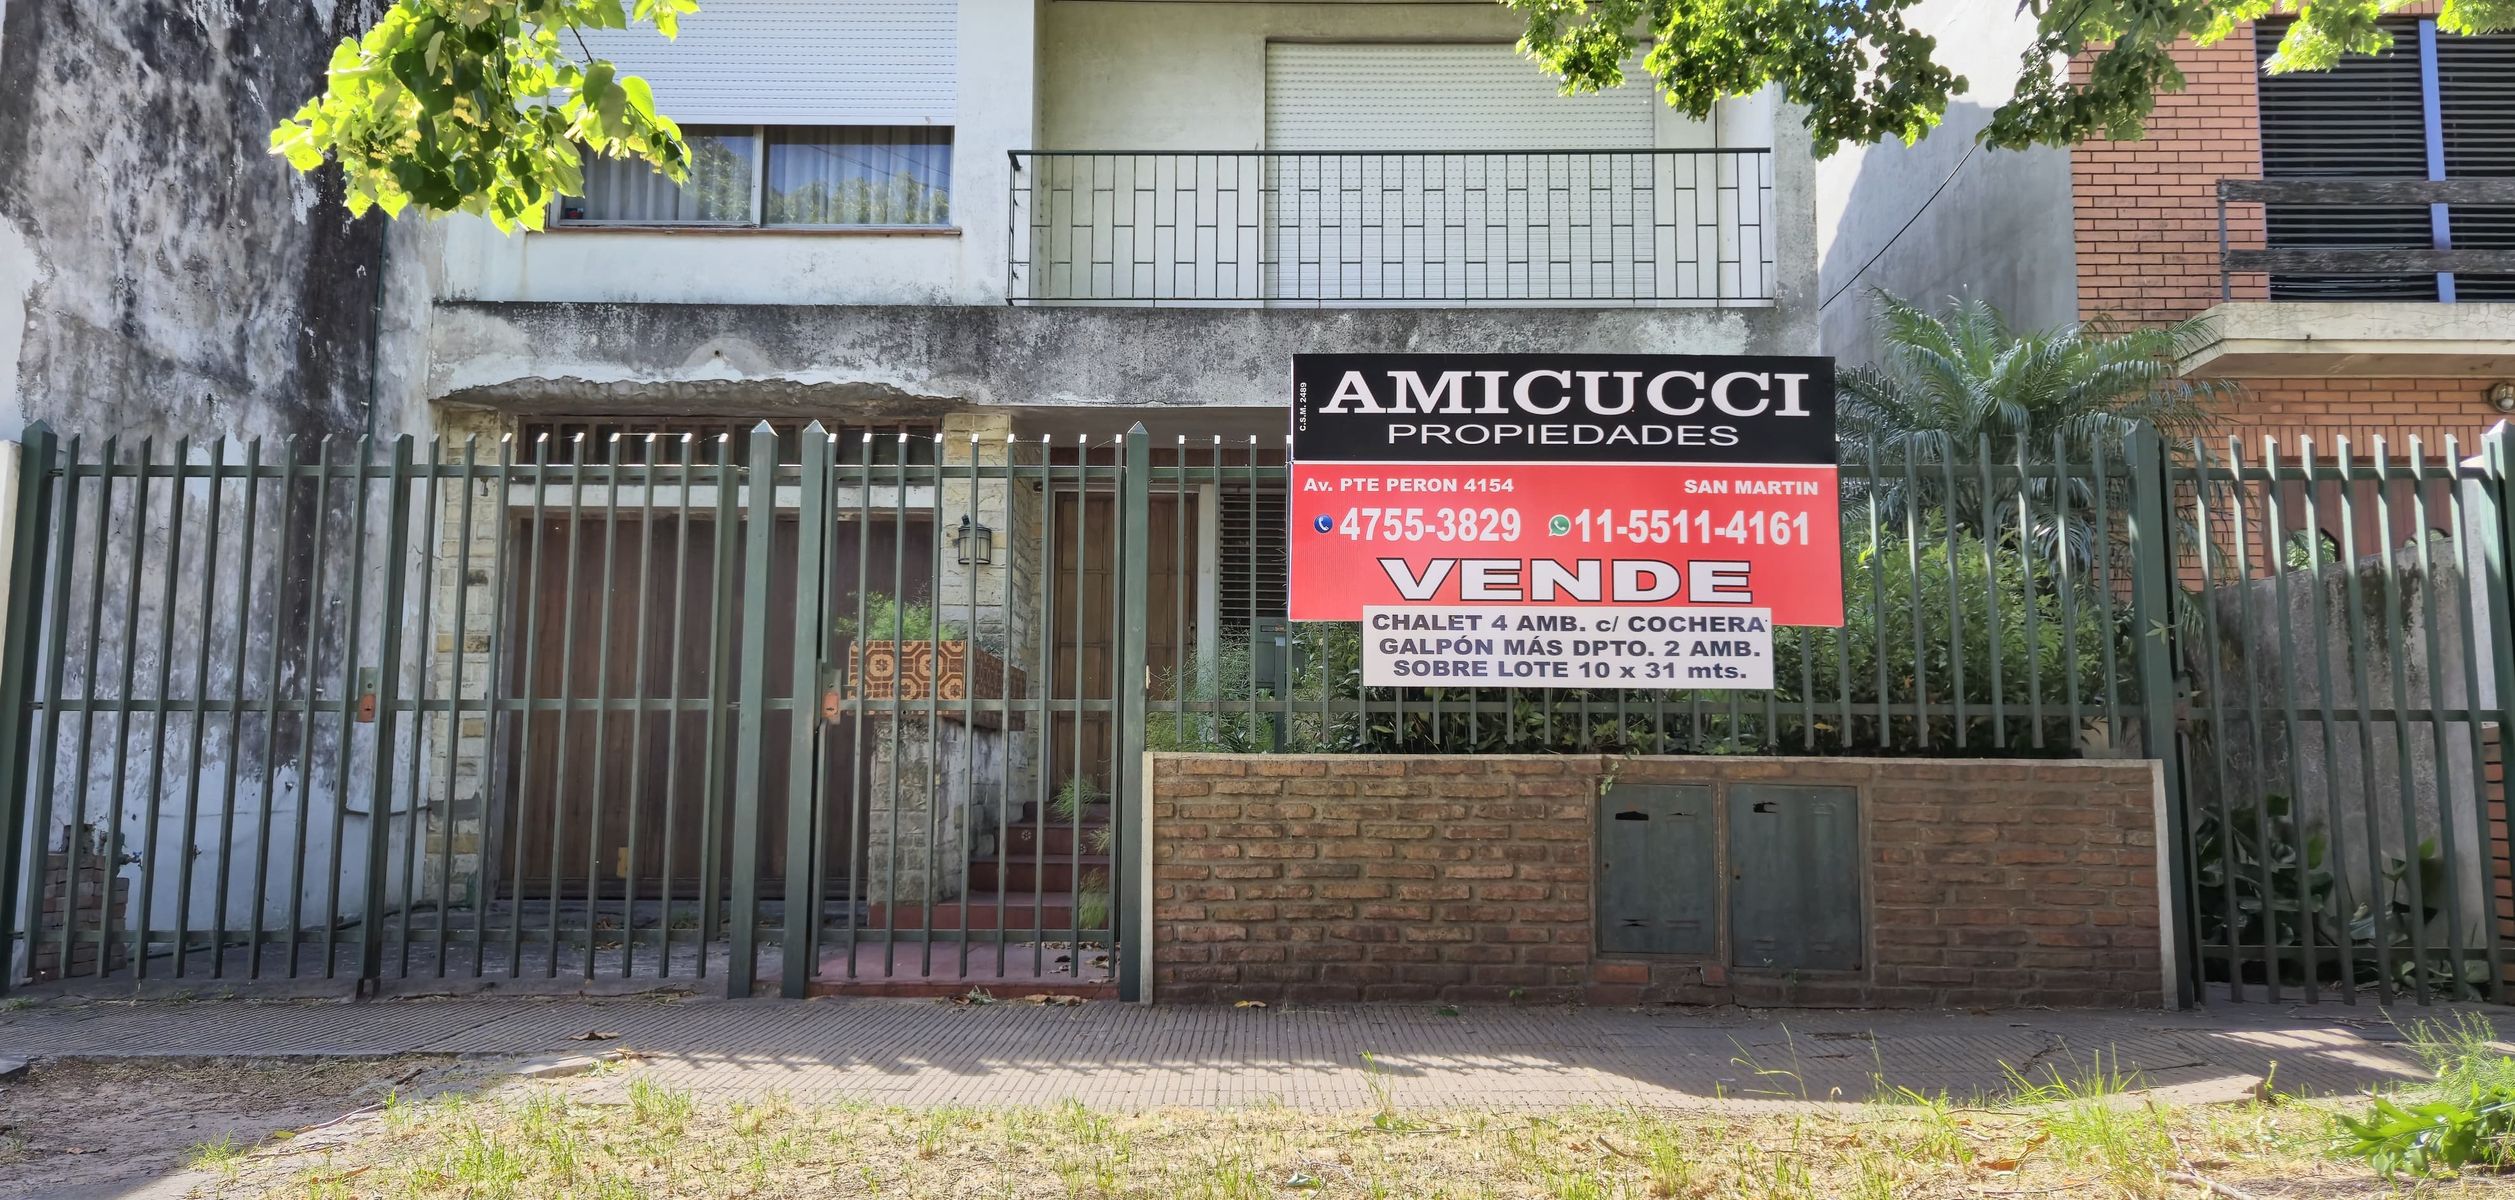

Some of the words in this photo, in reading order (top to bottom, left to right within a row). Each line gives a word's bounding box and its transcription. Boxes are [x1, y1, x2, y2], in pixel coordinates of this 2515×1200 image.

[1299, 382, 1307, 403] 2489
[1318, 369, 1811, 417] AMICUCCI
[1299, 405, 1307, 432] C.S.M.
[1388, 424, 1740, 446] PROPIEDADES
[1304, 478, 1333, 491] Av.
[1340, 478, 1380, 491] PTE
[1387, 478, 1457, 492] PERON
[1463, 478, 1514, 492] 4154
[1684, 480, 1729, 494] SAN
[1735, 480, 1818, 495] MARTIN
[1340, 508, 1521, 541] 4755-3829
[1575, 509, 1809, 545] 11-5511-4161
[1376, 558, 1753, 603] VENDE
[1372, 614, 1482, 630] CHALET
[1492, 615, 1507, 630] 4
[1516, 615, 1585, 631] AMB.
[1595, 615, 1618, 631] c/
[1627, 615, 1766, 633] COCHERA
[1379, 635, 1493, 654] GALPÓN
[1504, 636, 1564, 655] MÁS
[1573, 639, 1655, 656] DPTO.
[1664, 640, 1680, 656] 2
[1689, 640, 1761, 657] AMB.
[1393, 660, 1490, 677] SOBRE
[1499, 661, 1569, 677] LOTE
[1579, 661, 1611, 677] 10
[1620, 665, 1636, 679] x
[1645, 662, 1675, 678] 31
[1688, 662, 1747, 679] mts.
